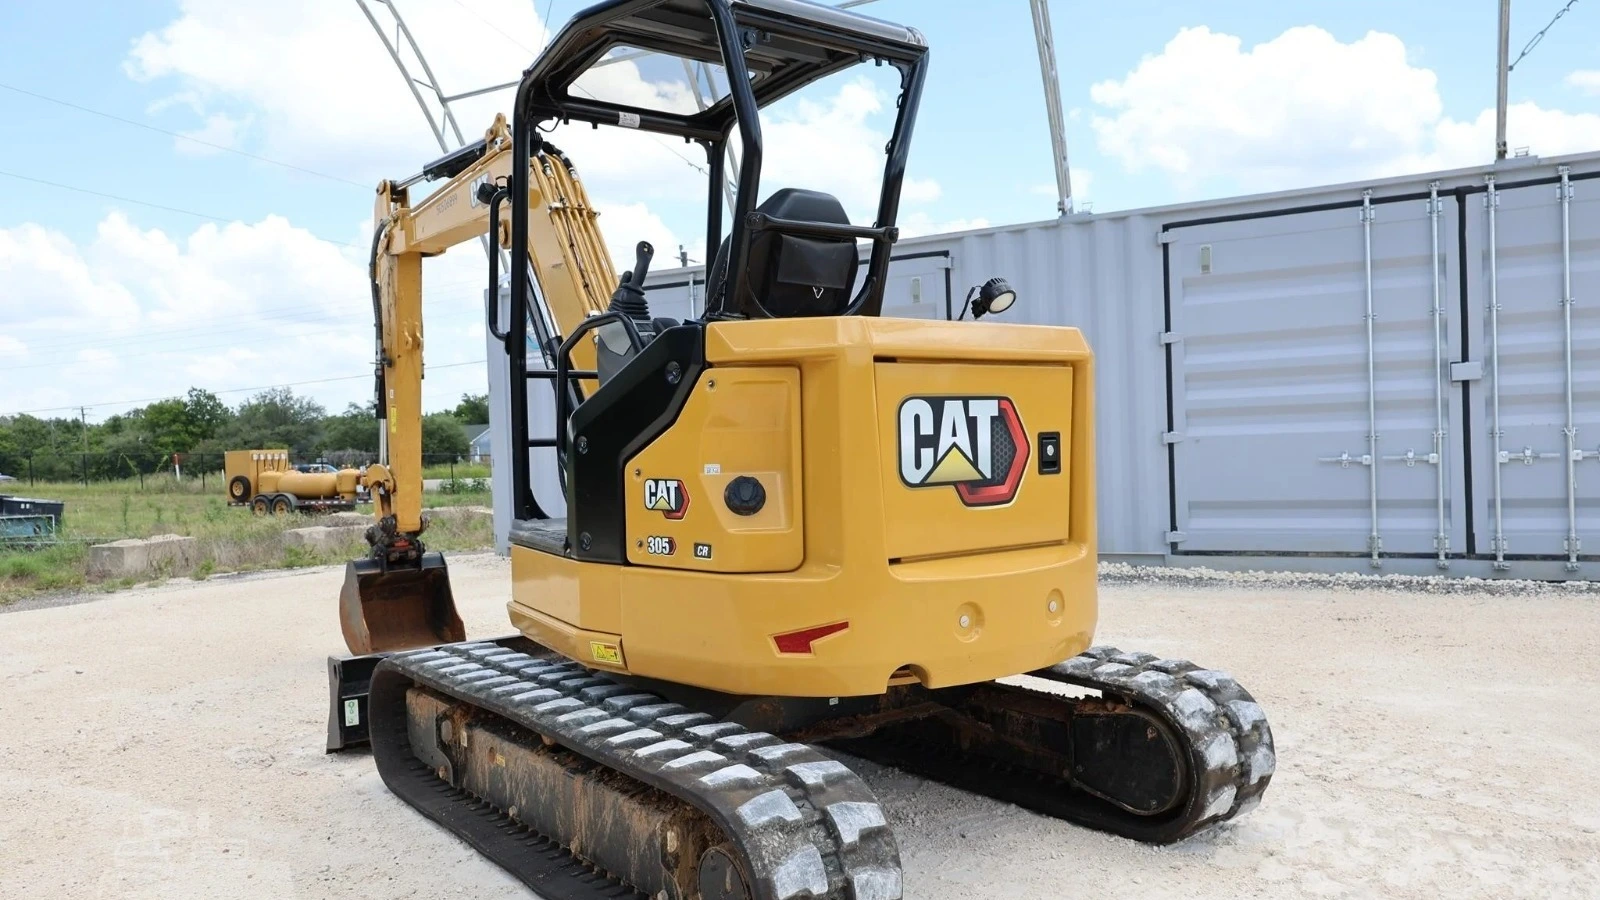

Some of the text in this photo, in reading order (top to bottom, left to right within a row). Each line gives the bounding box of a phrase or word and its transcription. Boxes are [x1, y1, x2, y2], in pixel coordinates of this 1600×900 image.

[900, 398, 999, 484] CAT
[645, 479, 678, 510] CAT
[647, 536, 670, 555] 305
[697, 545, 709, 557] CR
